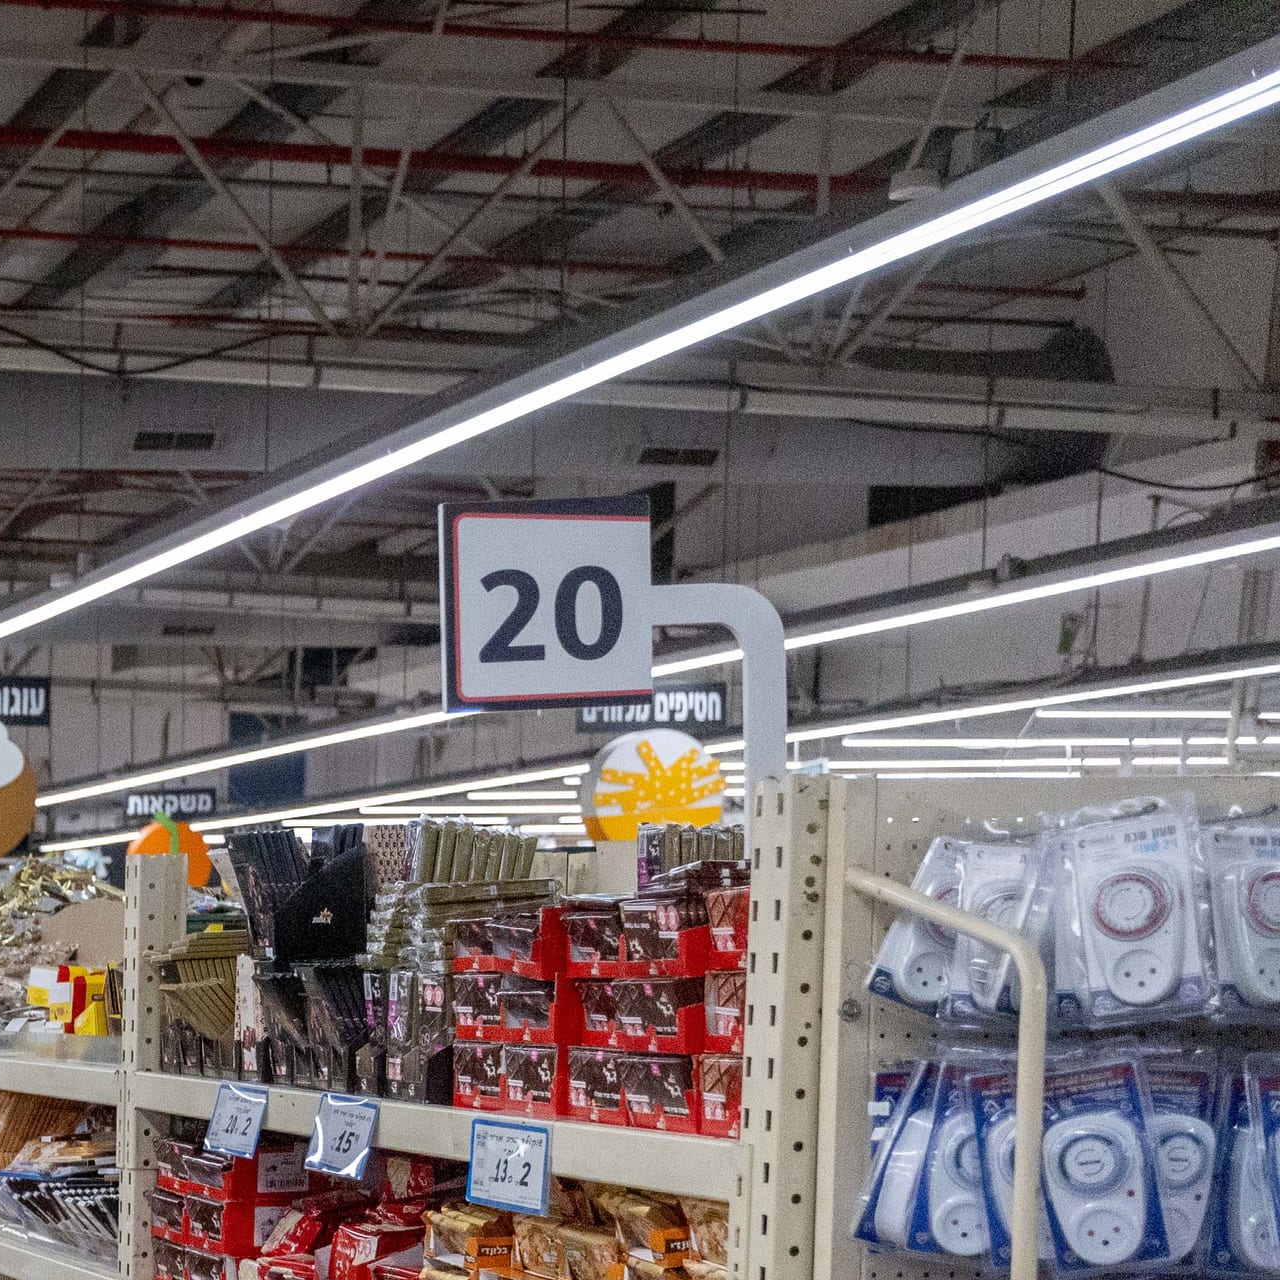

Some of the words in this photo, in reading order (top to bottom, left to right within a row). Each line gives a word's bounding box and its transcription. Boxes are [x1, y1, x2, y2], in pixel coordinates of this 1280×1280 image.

[479, 565, 625, 664] 20
[654, 690, 723, 723] חטיפים
[126, 794, 212, 816] משקאות
[334, 1130, 356, 1154] 15
[494, 1158, 509, 1184] 13
[519, 1161, 532, 1187] 2
[480, 1246, 509, 1256] בלונדי
